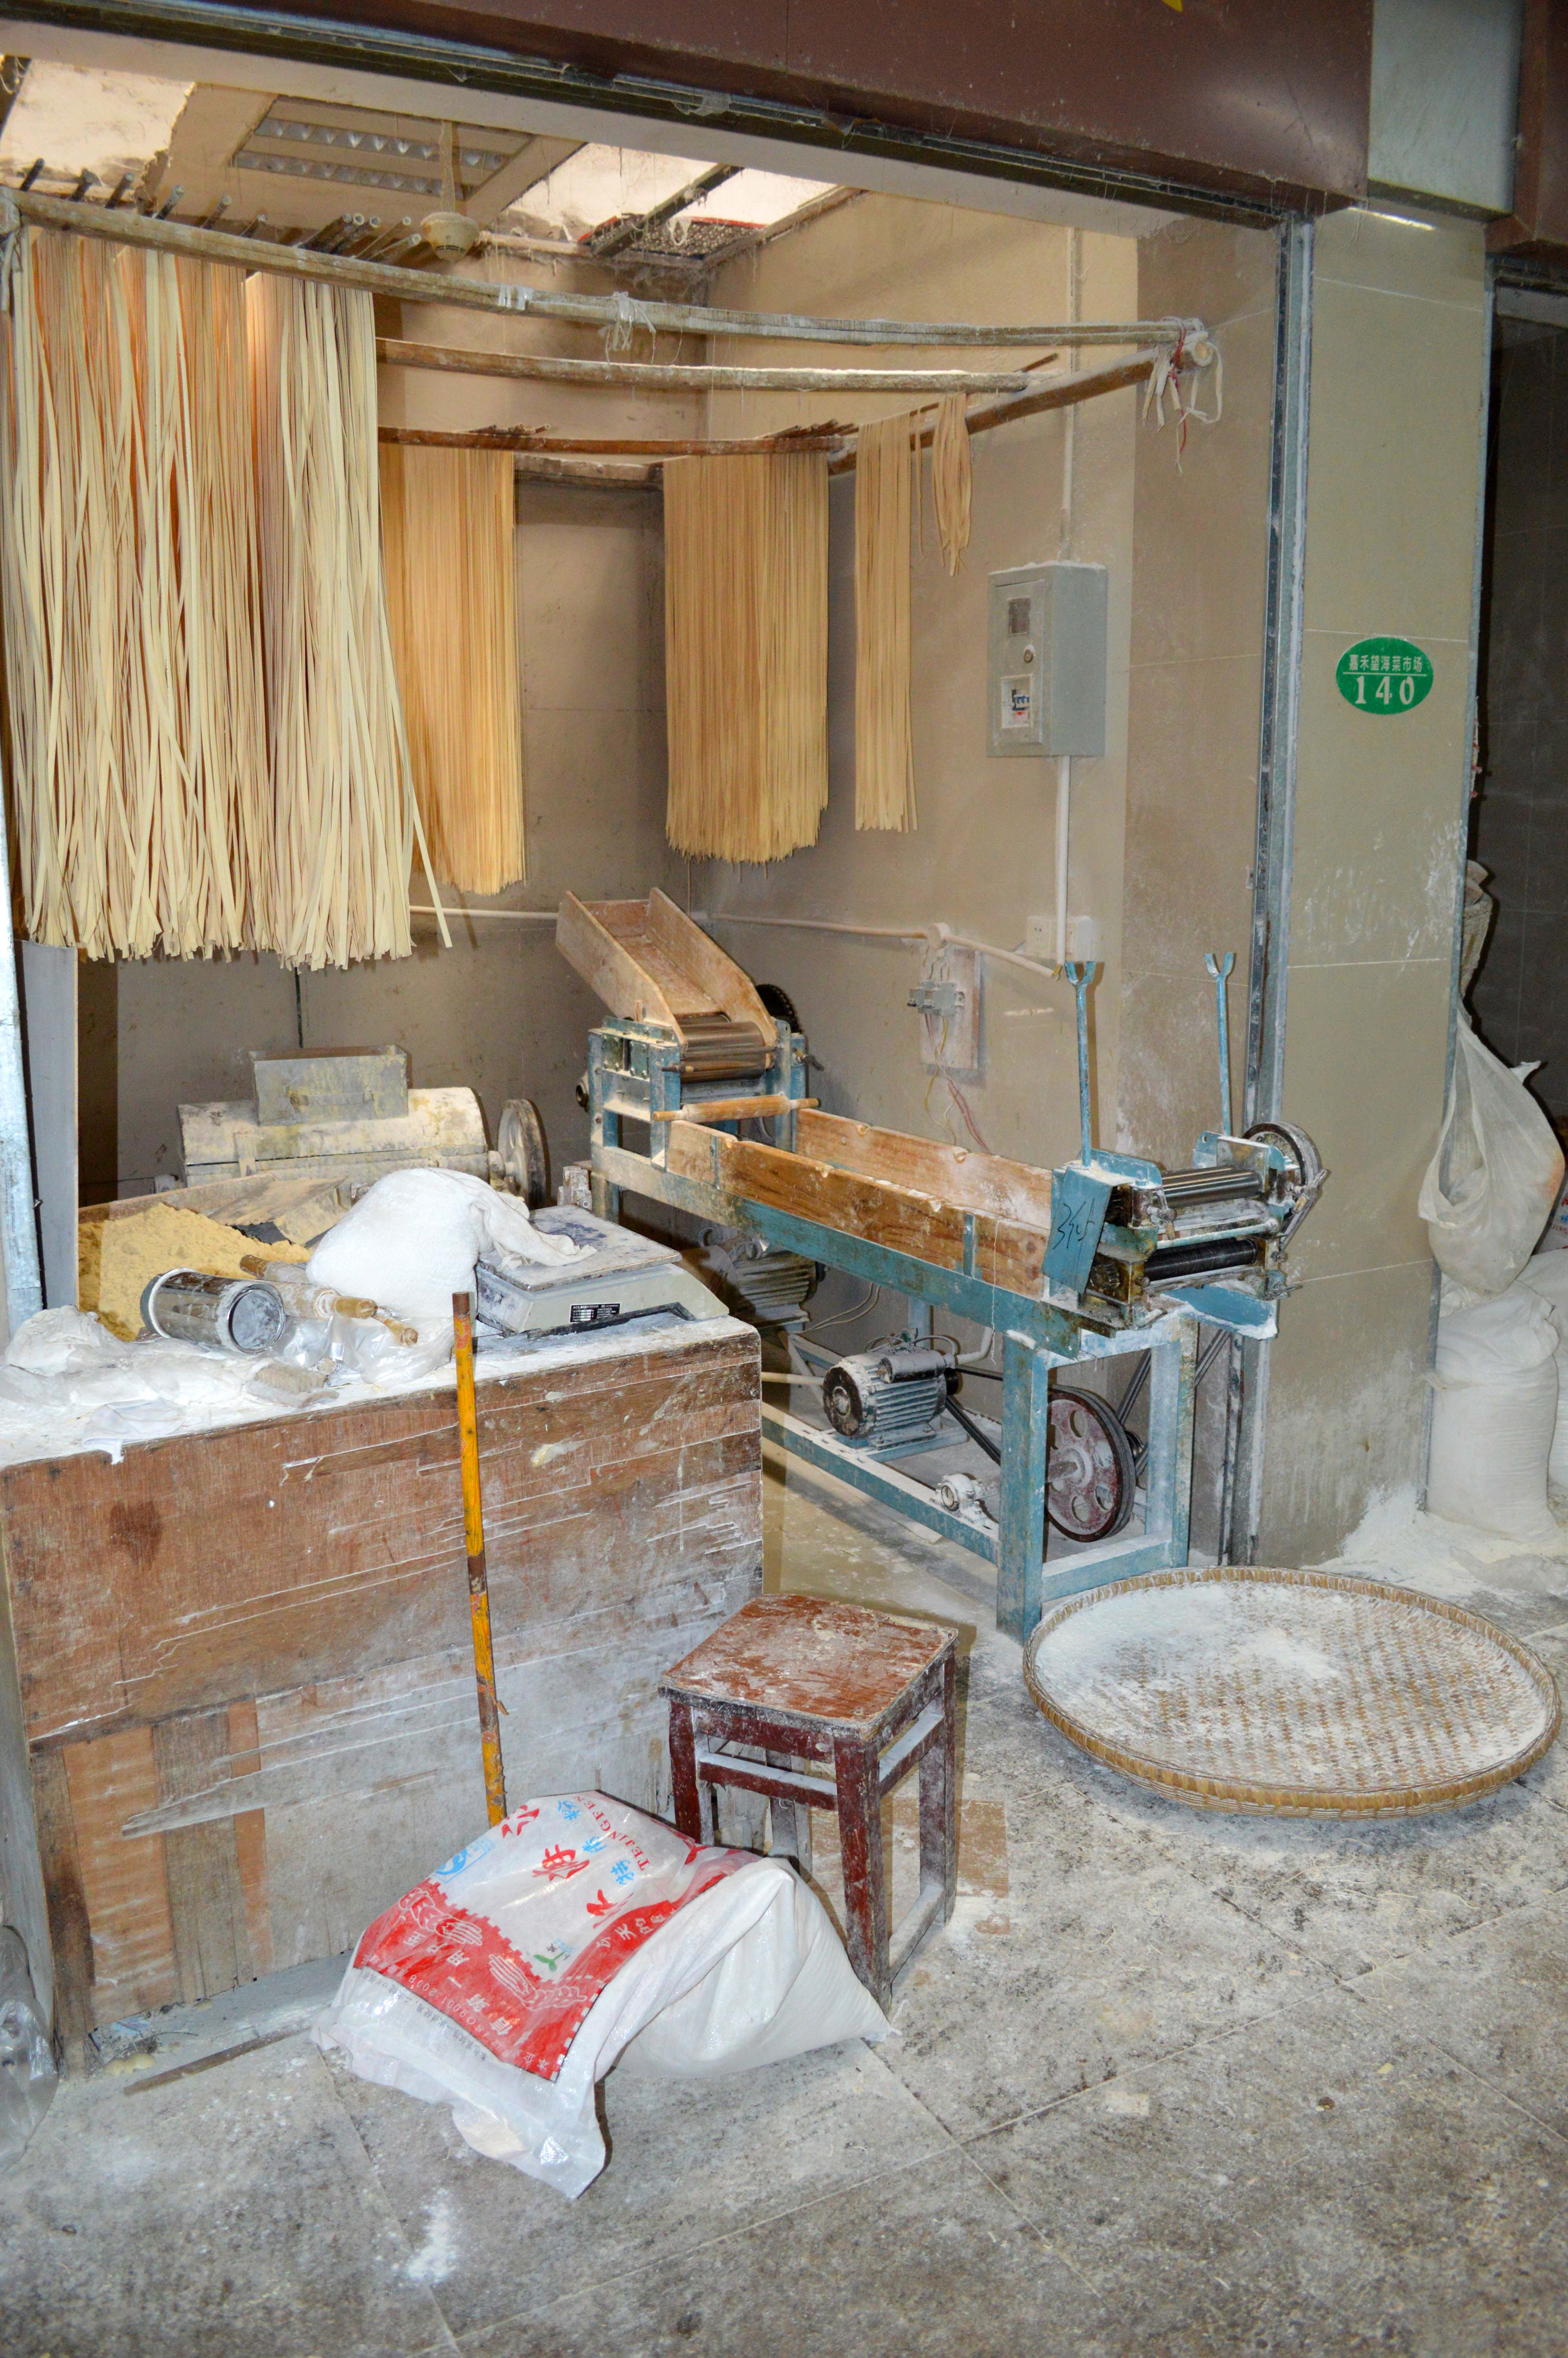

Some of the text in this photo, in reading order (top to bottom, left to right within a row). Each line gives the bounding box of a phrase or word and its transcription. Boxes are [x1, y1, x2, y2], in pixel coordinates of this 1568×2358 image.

[1349, 654, 1423, 673] 嘉禾望海菜市场
[1354, 675, 1415, 705] 140
